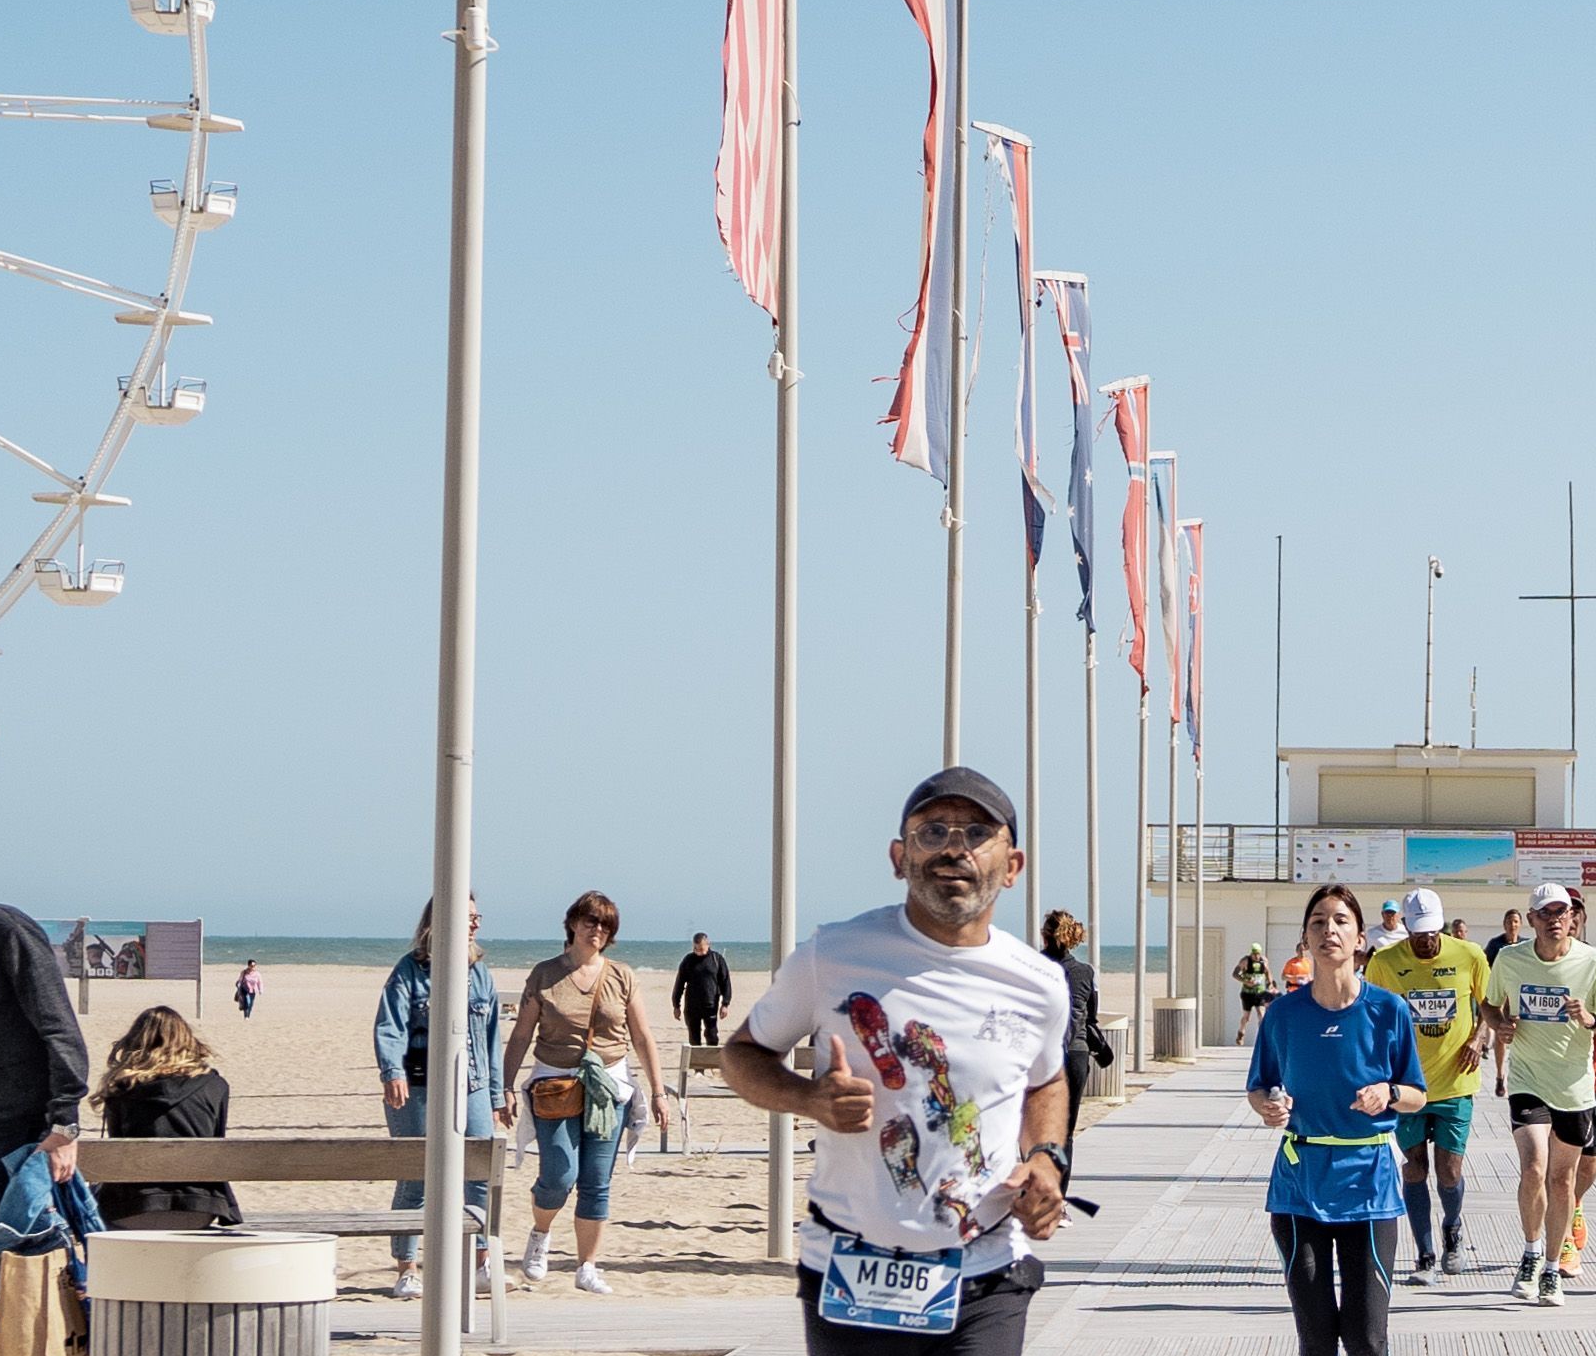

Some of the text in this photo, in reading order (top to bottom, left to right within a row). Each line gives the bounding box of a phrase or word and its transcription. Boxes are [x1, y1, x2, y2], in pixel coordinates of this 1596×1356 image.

[1418, 999, 1447, 1010] M 2144
[1528, 995, 1560, 1008] M 1608
[857, 1259, 930, 1291] M 696
